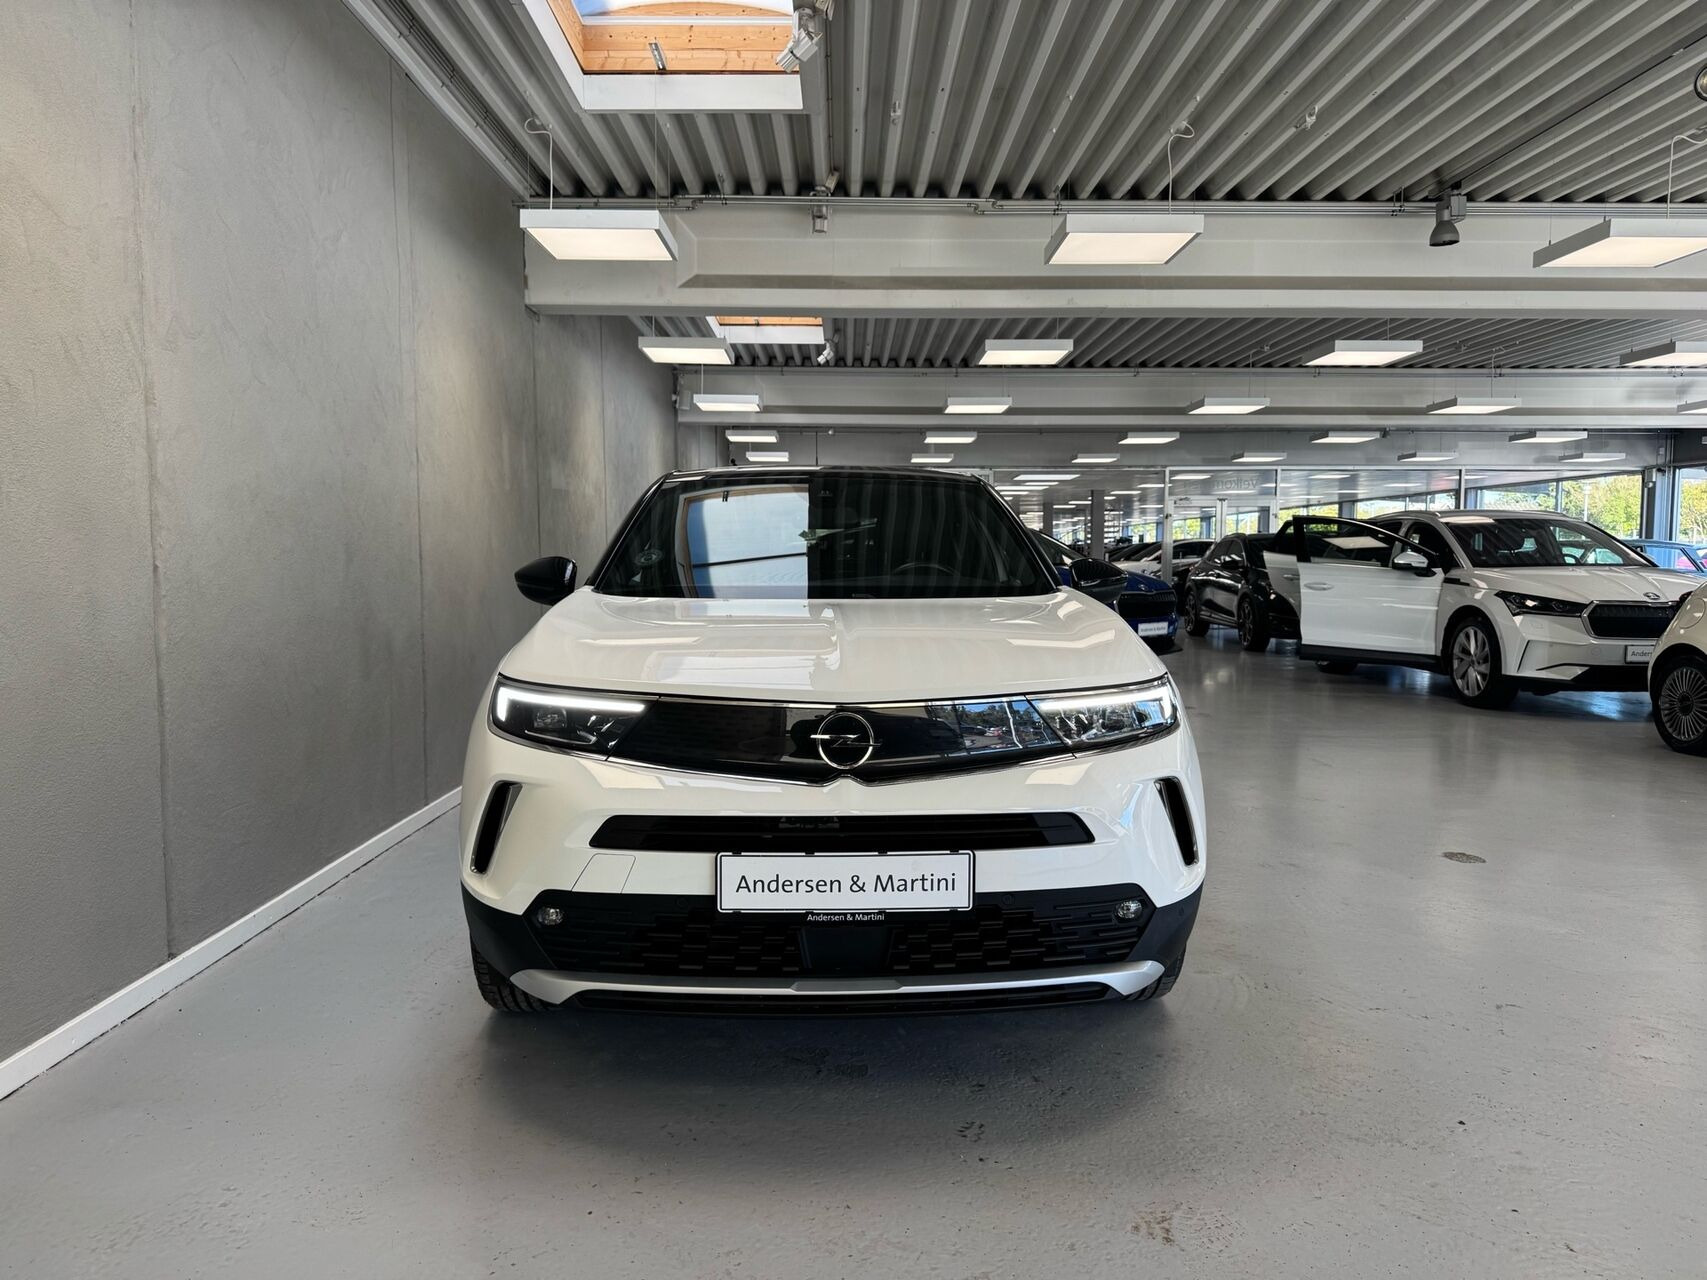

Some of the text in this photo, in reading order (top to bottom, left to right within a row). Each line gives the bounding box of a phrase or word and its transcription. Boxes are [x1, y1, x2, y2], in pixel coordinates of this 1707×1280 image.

[735, 873, 956, 893] Andersen & Martini
[807, 913, 885, 921] Andersen & Martini
